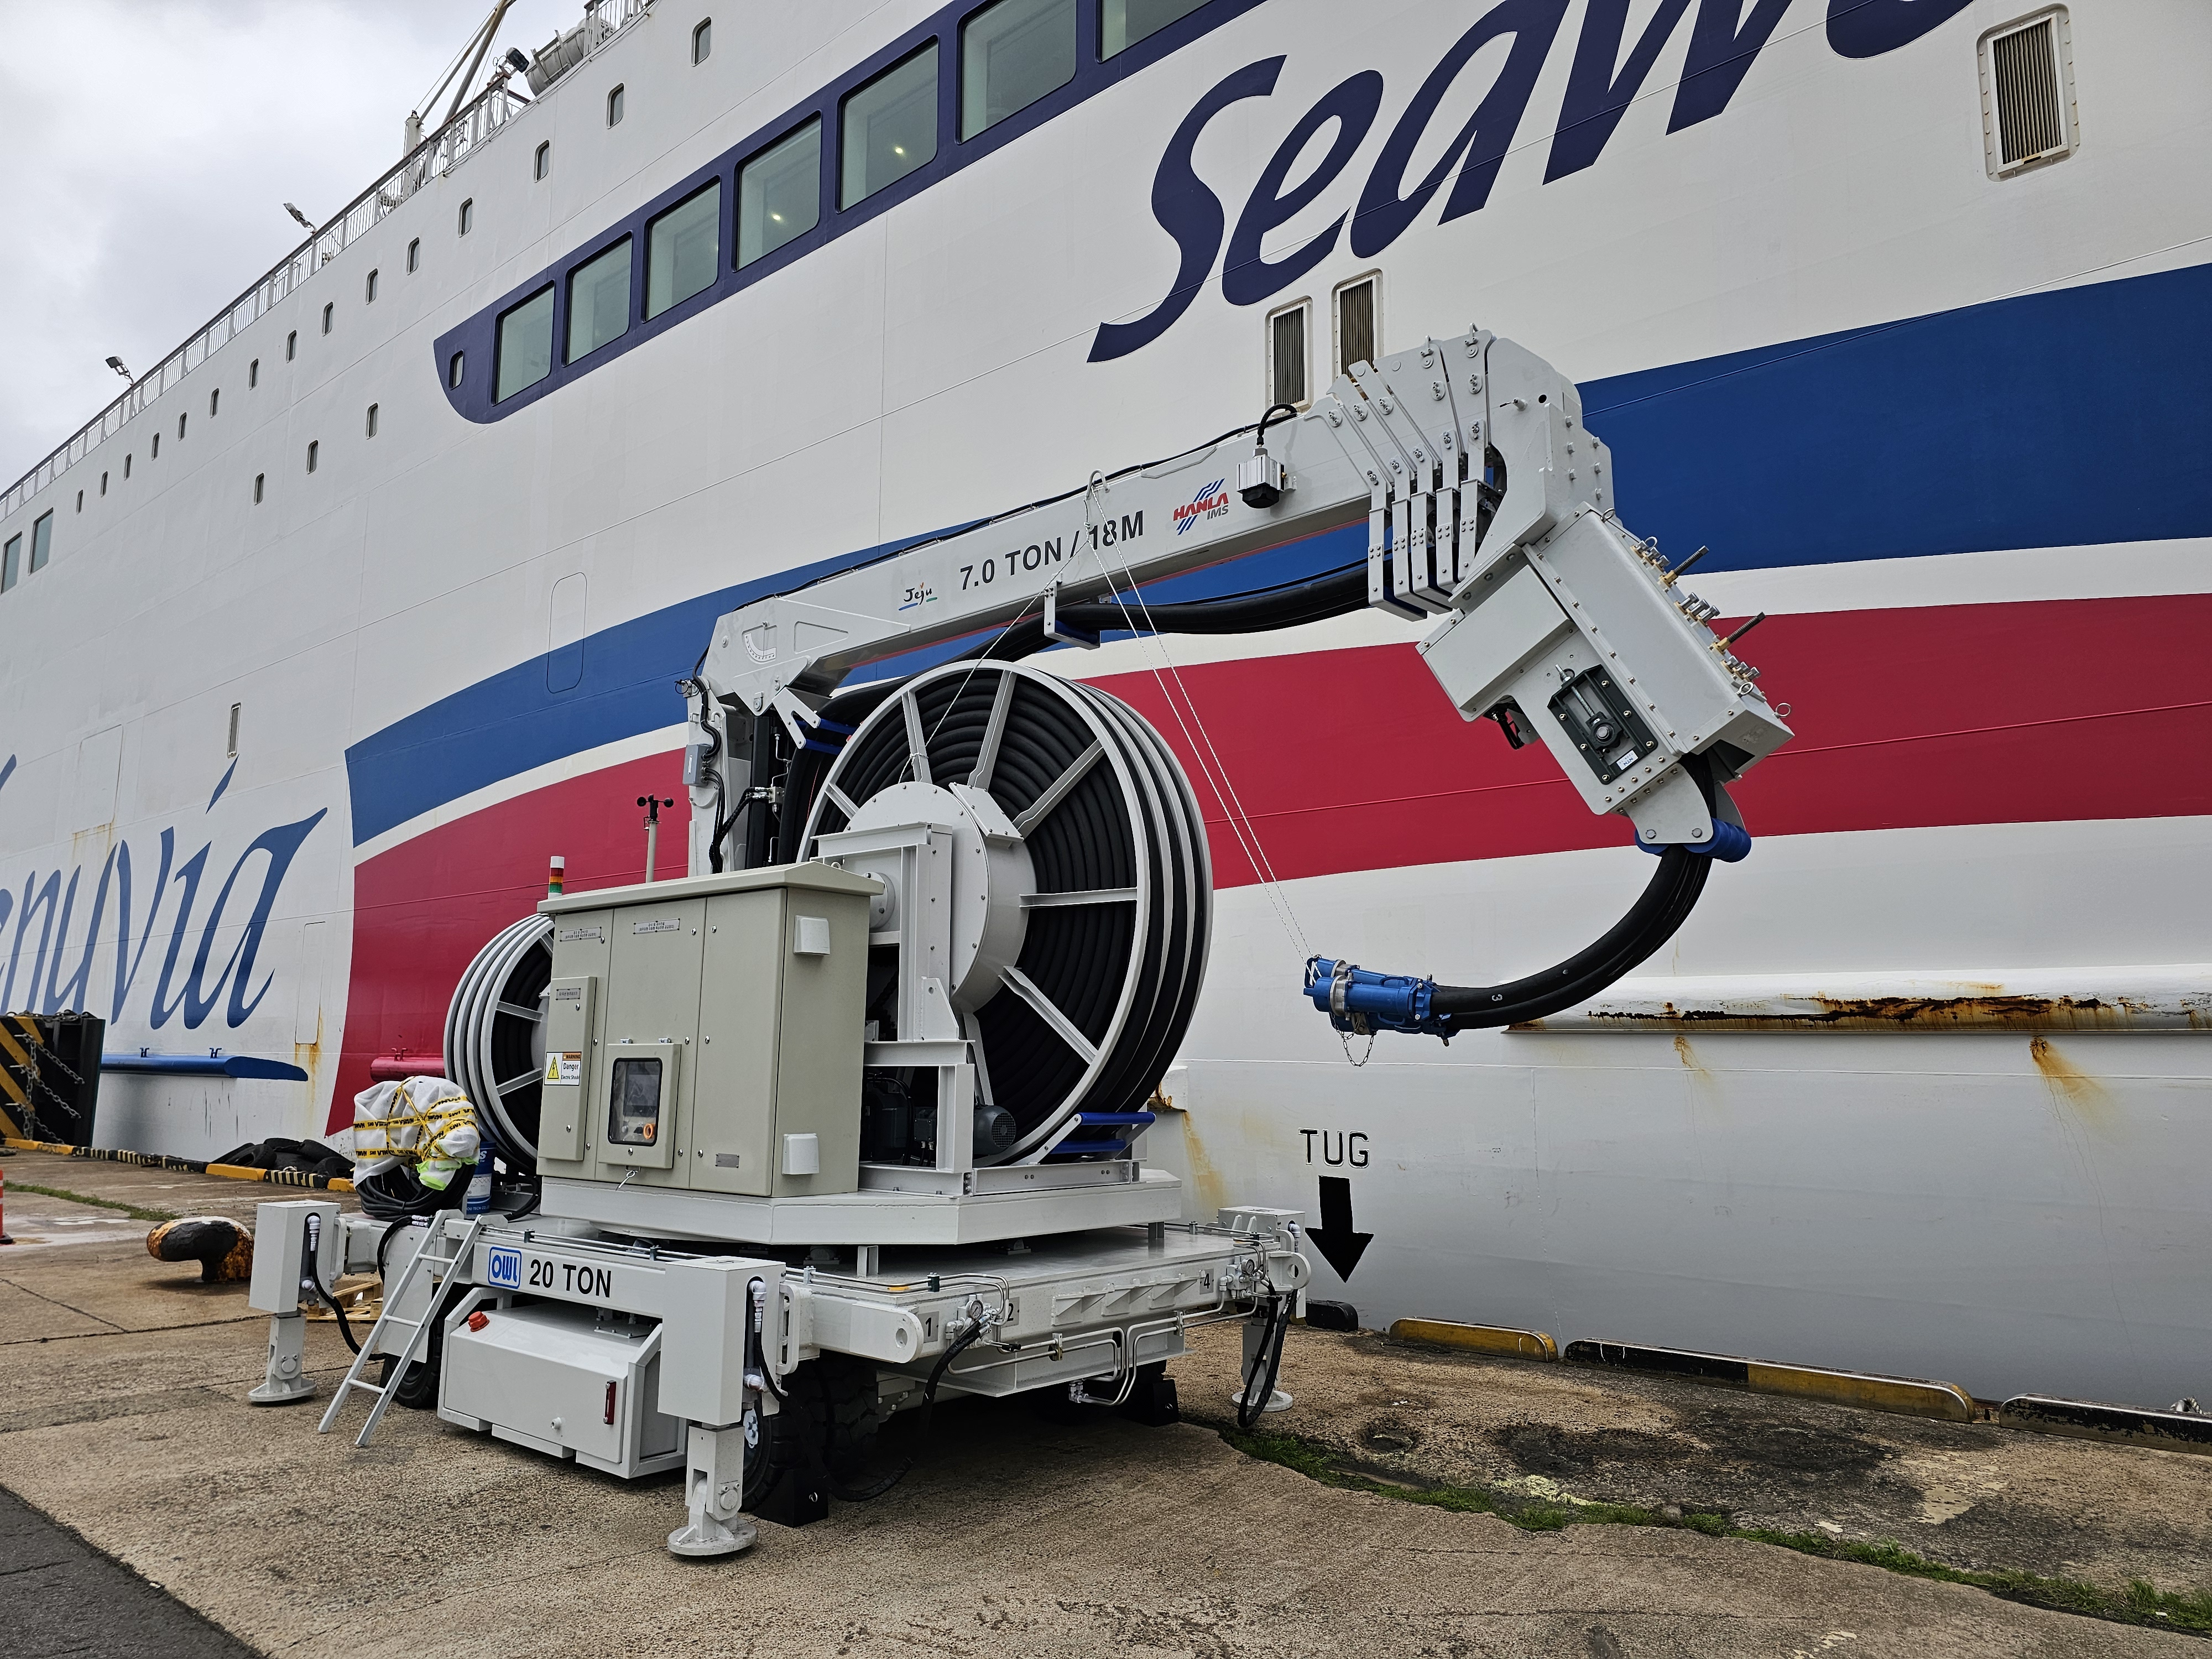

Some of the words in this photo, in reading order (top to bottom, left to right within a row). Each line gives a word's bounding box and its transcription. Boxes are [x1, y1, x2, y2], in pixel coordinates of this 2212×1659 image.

[1173, 492, 1229, 521] HANLA
[1207, 505, 1229, 520] IMS
[960, 559, 995, 591] 7.0
[1005, 536, 1062, 576] TON
[904, 582, 932, 605] Jeju
[564, 1063, 578, 1071] Danger
[1298, 1128, 1370, 1168] TUG
[529, 1259, 553, 1288] 20
[562, 1264, 612, 1298] TON
[1204, 1274, 1210, 1289] 4
[925, 1317, 932, 1337] 1
